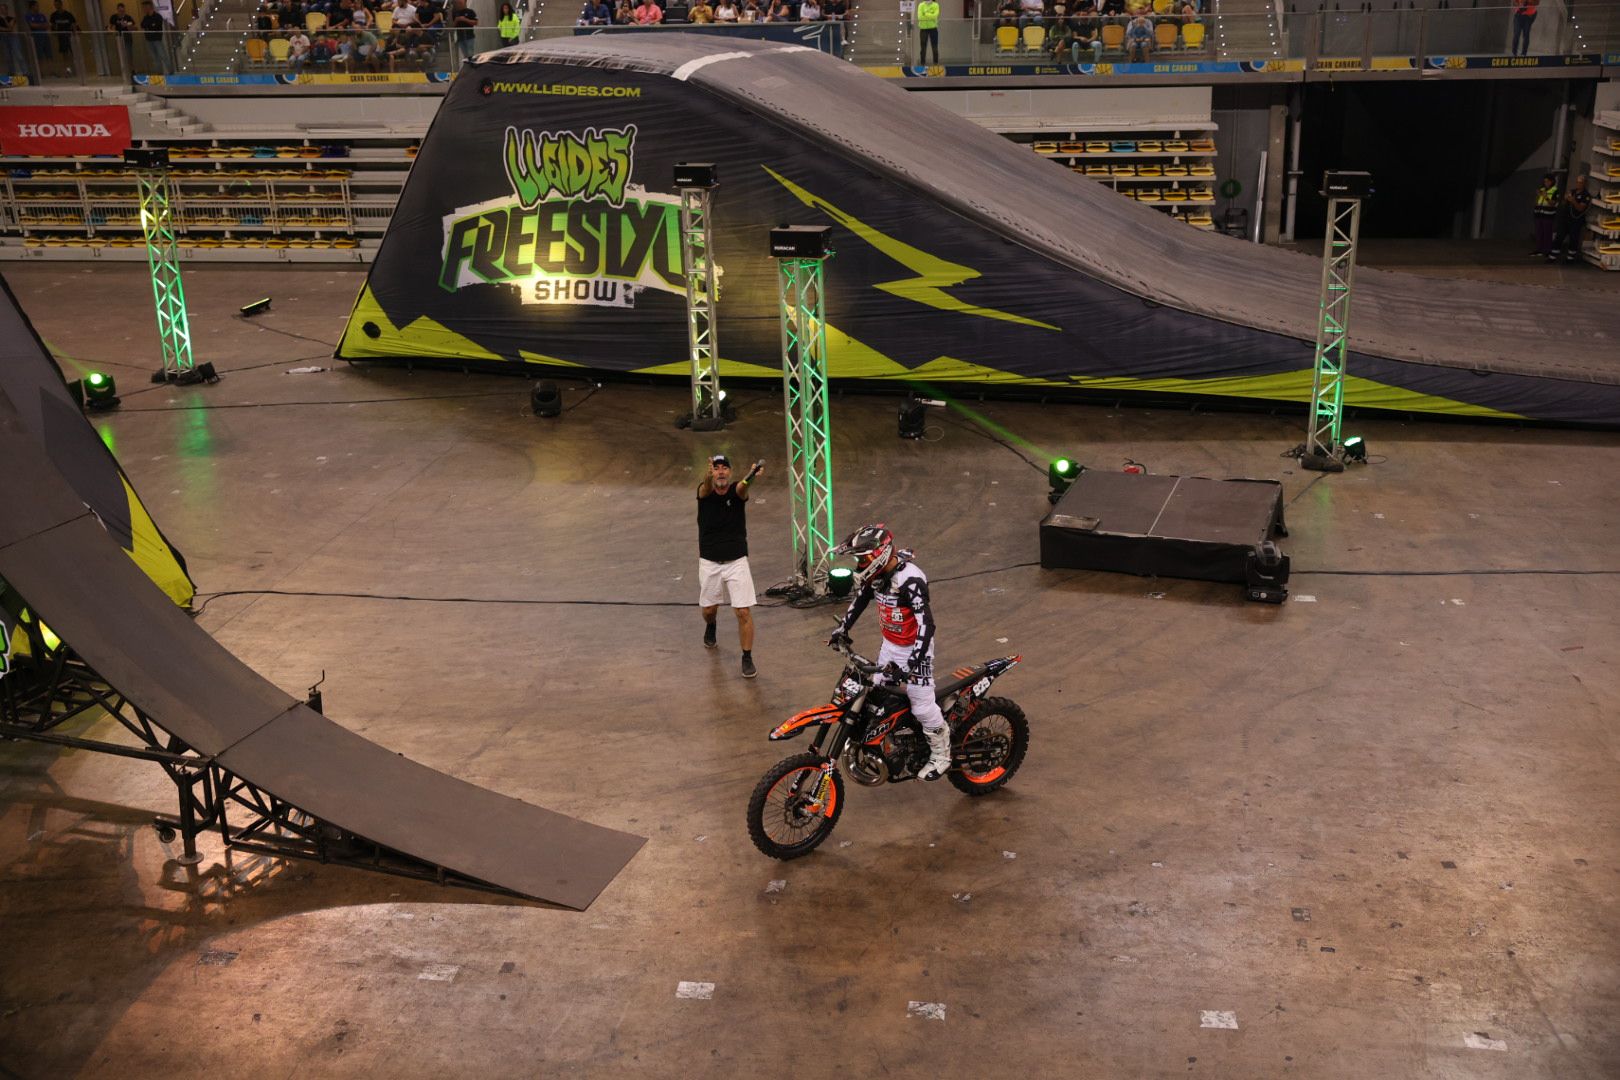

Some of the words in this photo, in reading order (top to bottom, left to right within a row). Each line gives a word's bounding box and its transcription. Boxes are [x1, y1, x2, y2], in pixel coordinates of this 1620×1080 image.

[968, 67, 984, 75] GRAN
[986, 67, 1012, 75] CANARIA
[18, 124, 111, 137] HONDA
[504, 125, 637, 209] LLEIDES
[534, 280, 617, 302] SHOW
